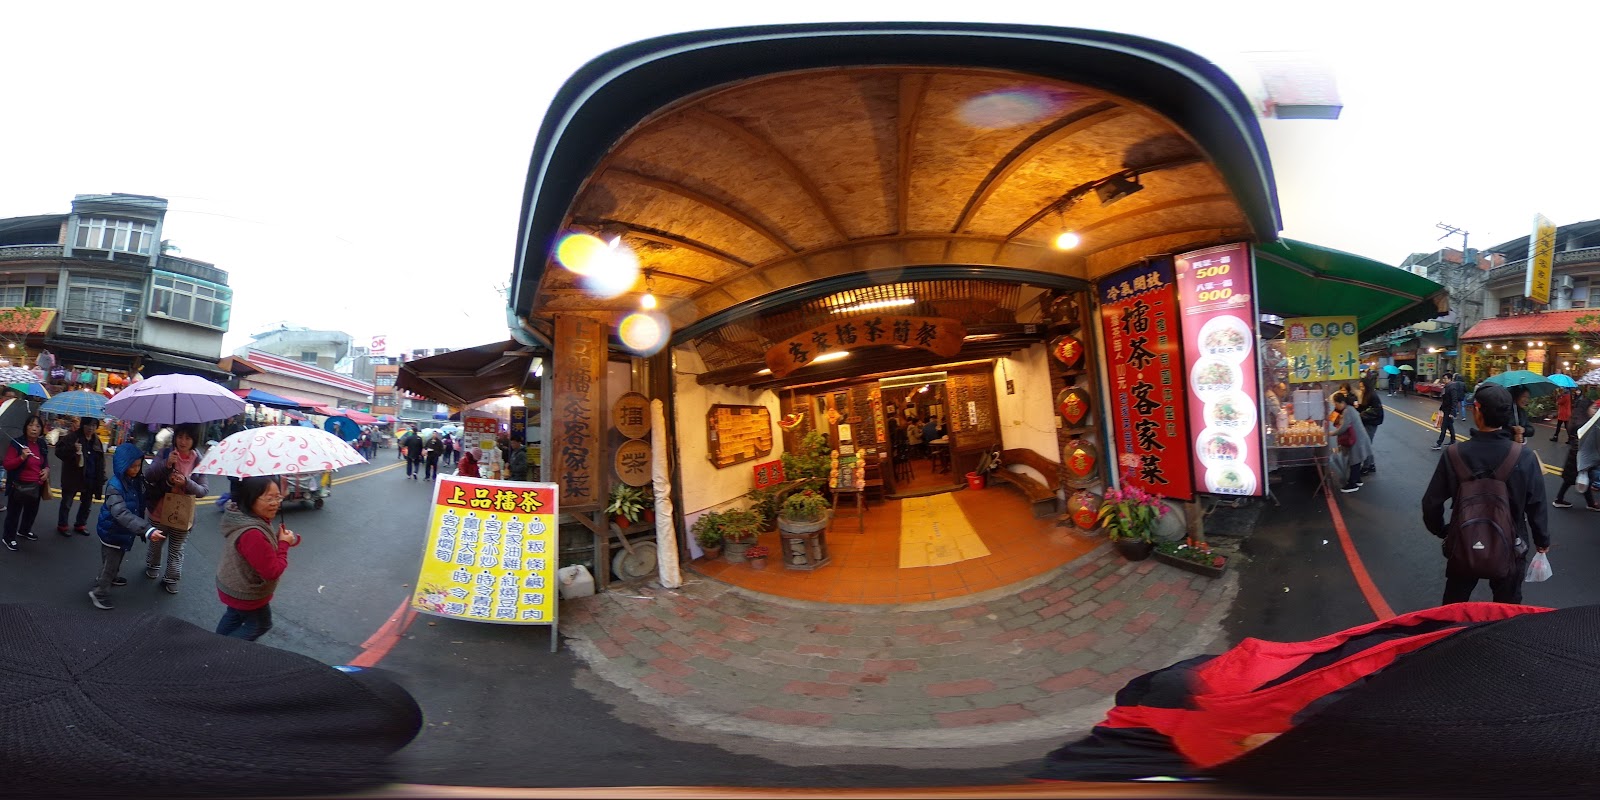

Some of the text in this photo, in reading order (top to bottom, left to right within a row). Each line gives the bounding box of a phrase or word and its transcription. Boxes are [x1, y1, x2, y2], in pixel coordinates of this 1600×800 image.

[1107, 271, 1164, 300] 冷氣開放
[1195, 264, 1230, 279] 500
[1198, 288, 1232, 302] 900
[371, 338, 386, 348] OK
[447, 486, 544, 513] 上品擂茶
[480, 519, 503, 568] 客家小炒
[503, 521, 524, 570] 客家油雞
[470, 573, 495, 617] 時令青菜
[496, 576, 520, 619] 紅燒豆腐
